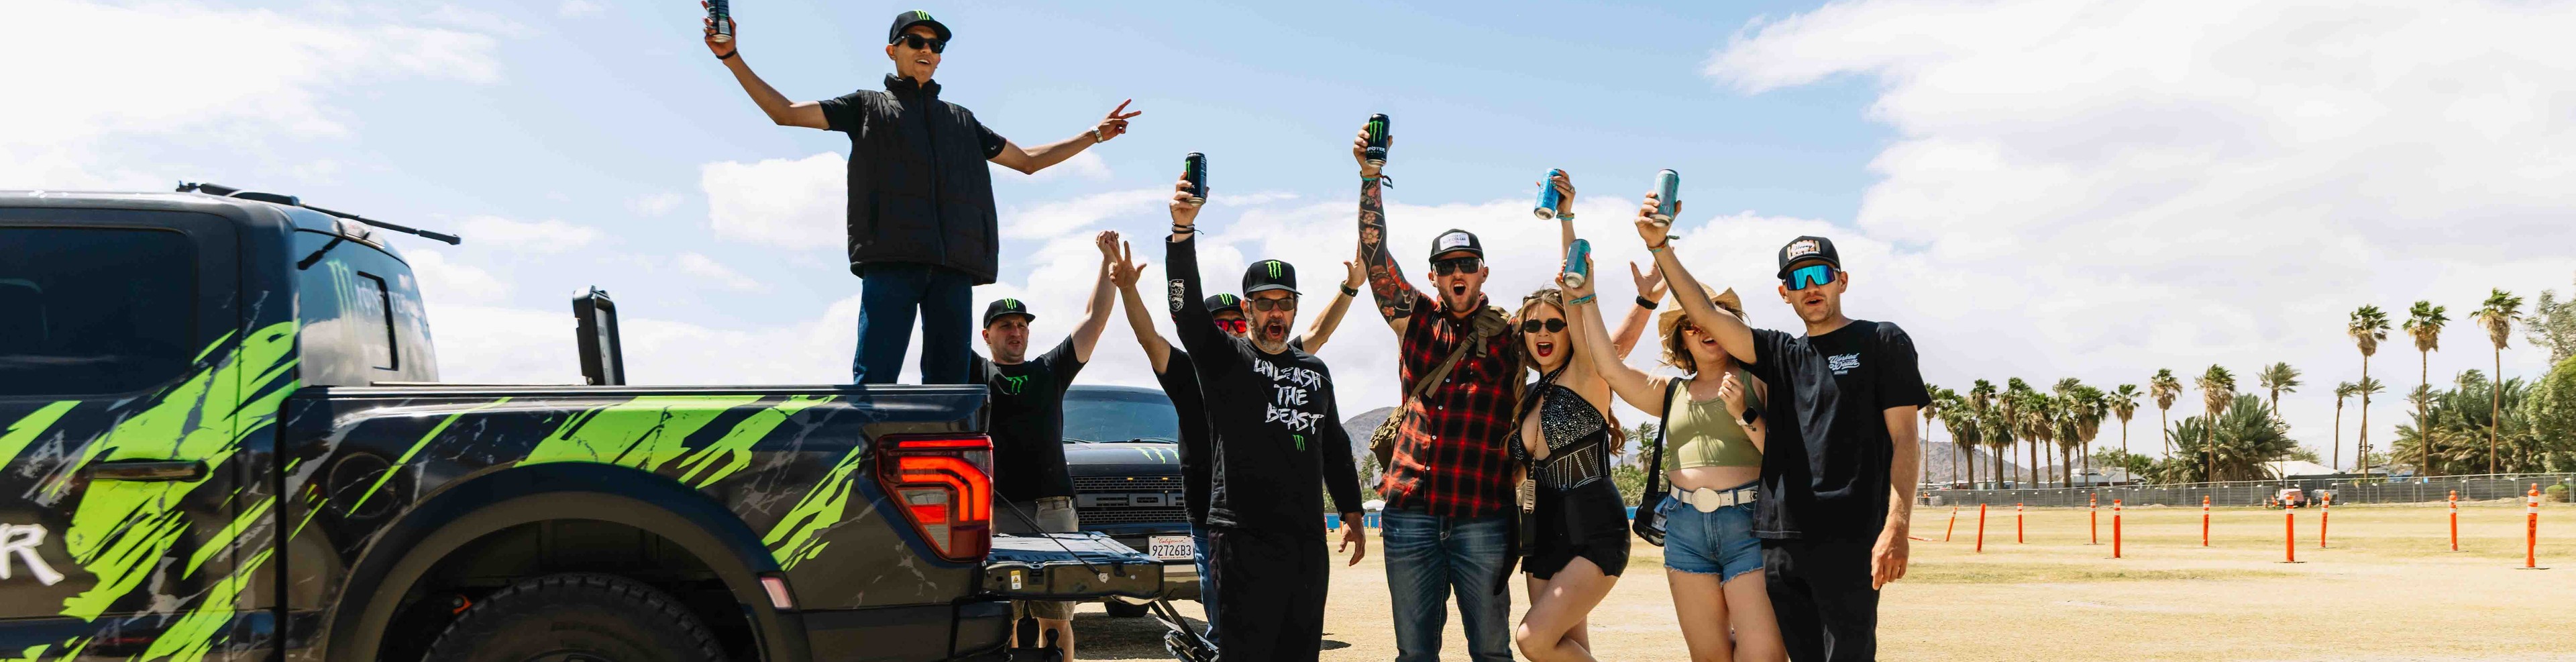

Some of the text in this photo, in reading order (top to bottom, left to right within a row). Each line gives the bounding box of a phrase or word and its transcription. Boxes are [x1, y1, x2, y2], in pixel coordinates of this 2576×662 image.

[1254, 357, 1321, 391] UNLEASH
[1274, 384, 1308, 407] THE
[1265, 402, 1324, 435] BEAST
[1152, 545, 1191, 557] 92726B3
